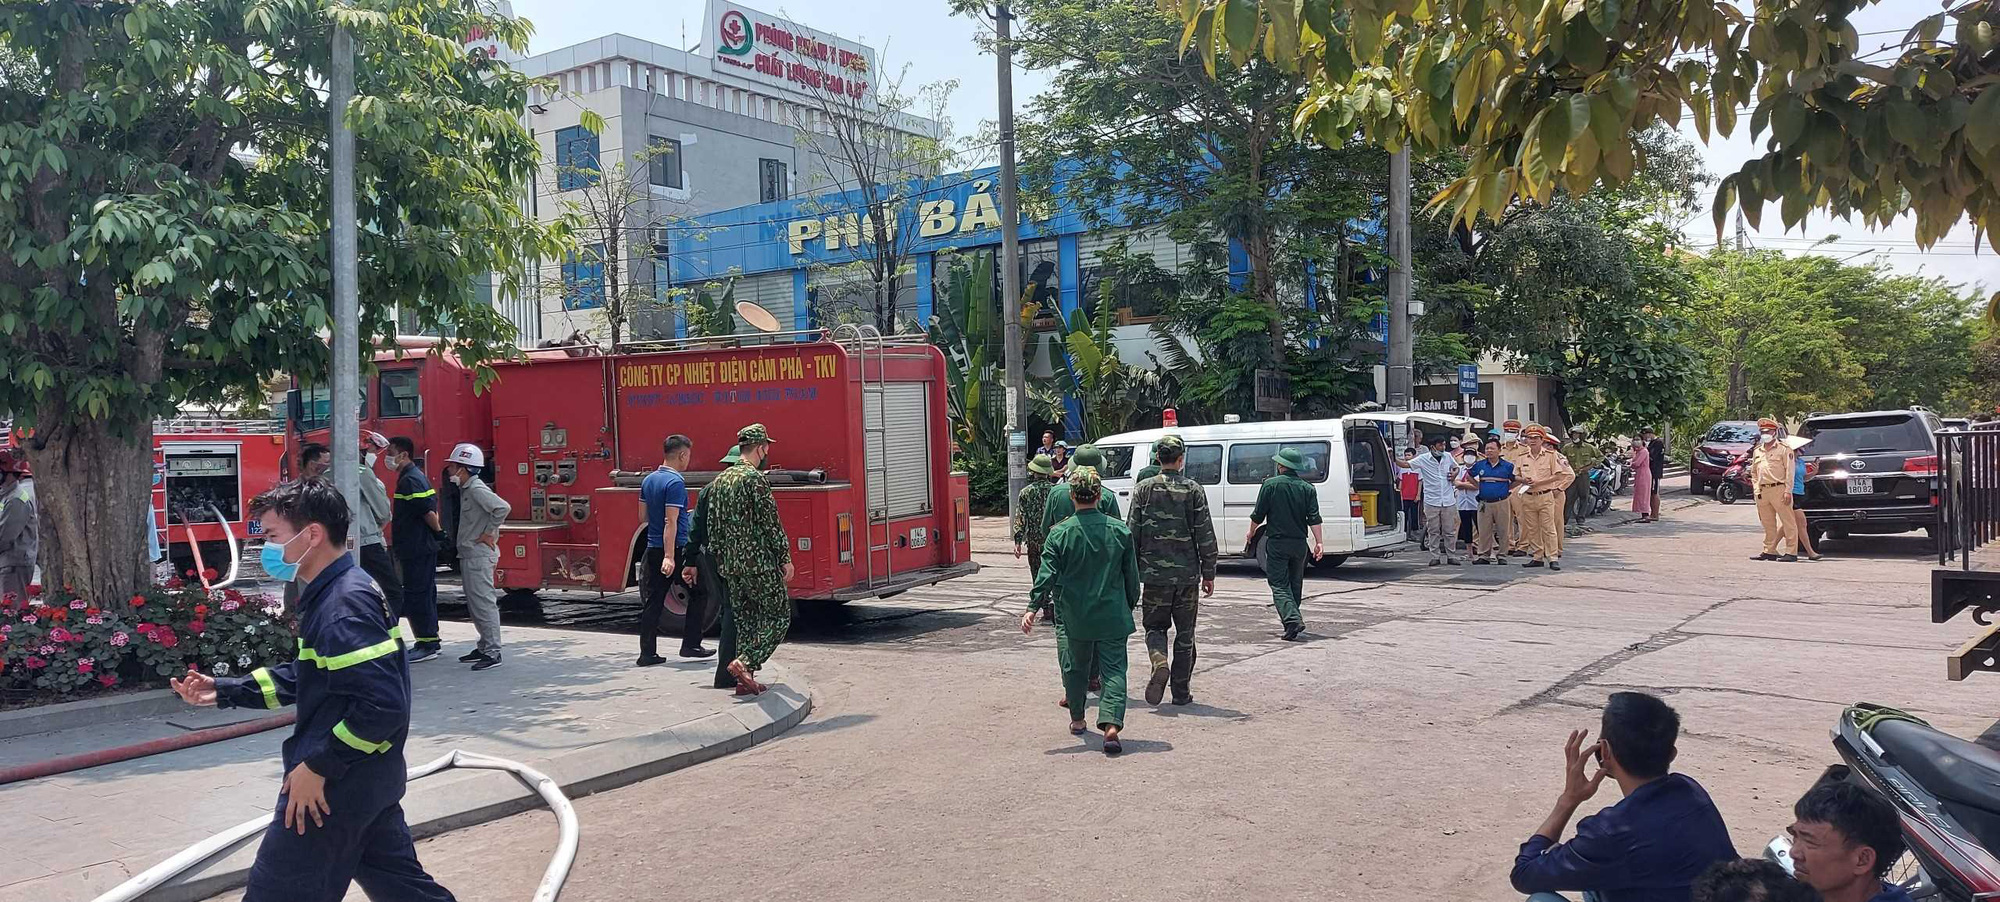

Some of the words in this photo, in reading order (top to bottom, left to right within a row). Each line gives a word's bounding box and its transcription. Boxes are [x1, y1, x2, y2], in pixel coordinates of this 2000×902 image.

[620, 361, 649, 387] CÔNG
[650, 364, 663, 386] TY
[666, 363, 681, 385] CP
[683, 357, 715, 388] NHIỆT
[719, 356, 747, 386] ĐIỆN
[814, 354, 836, 379] TKV
